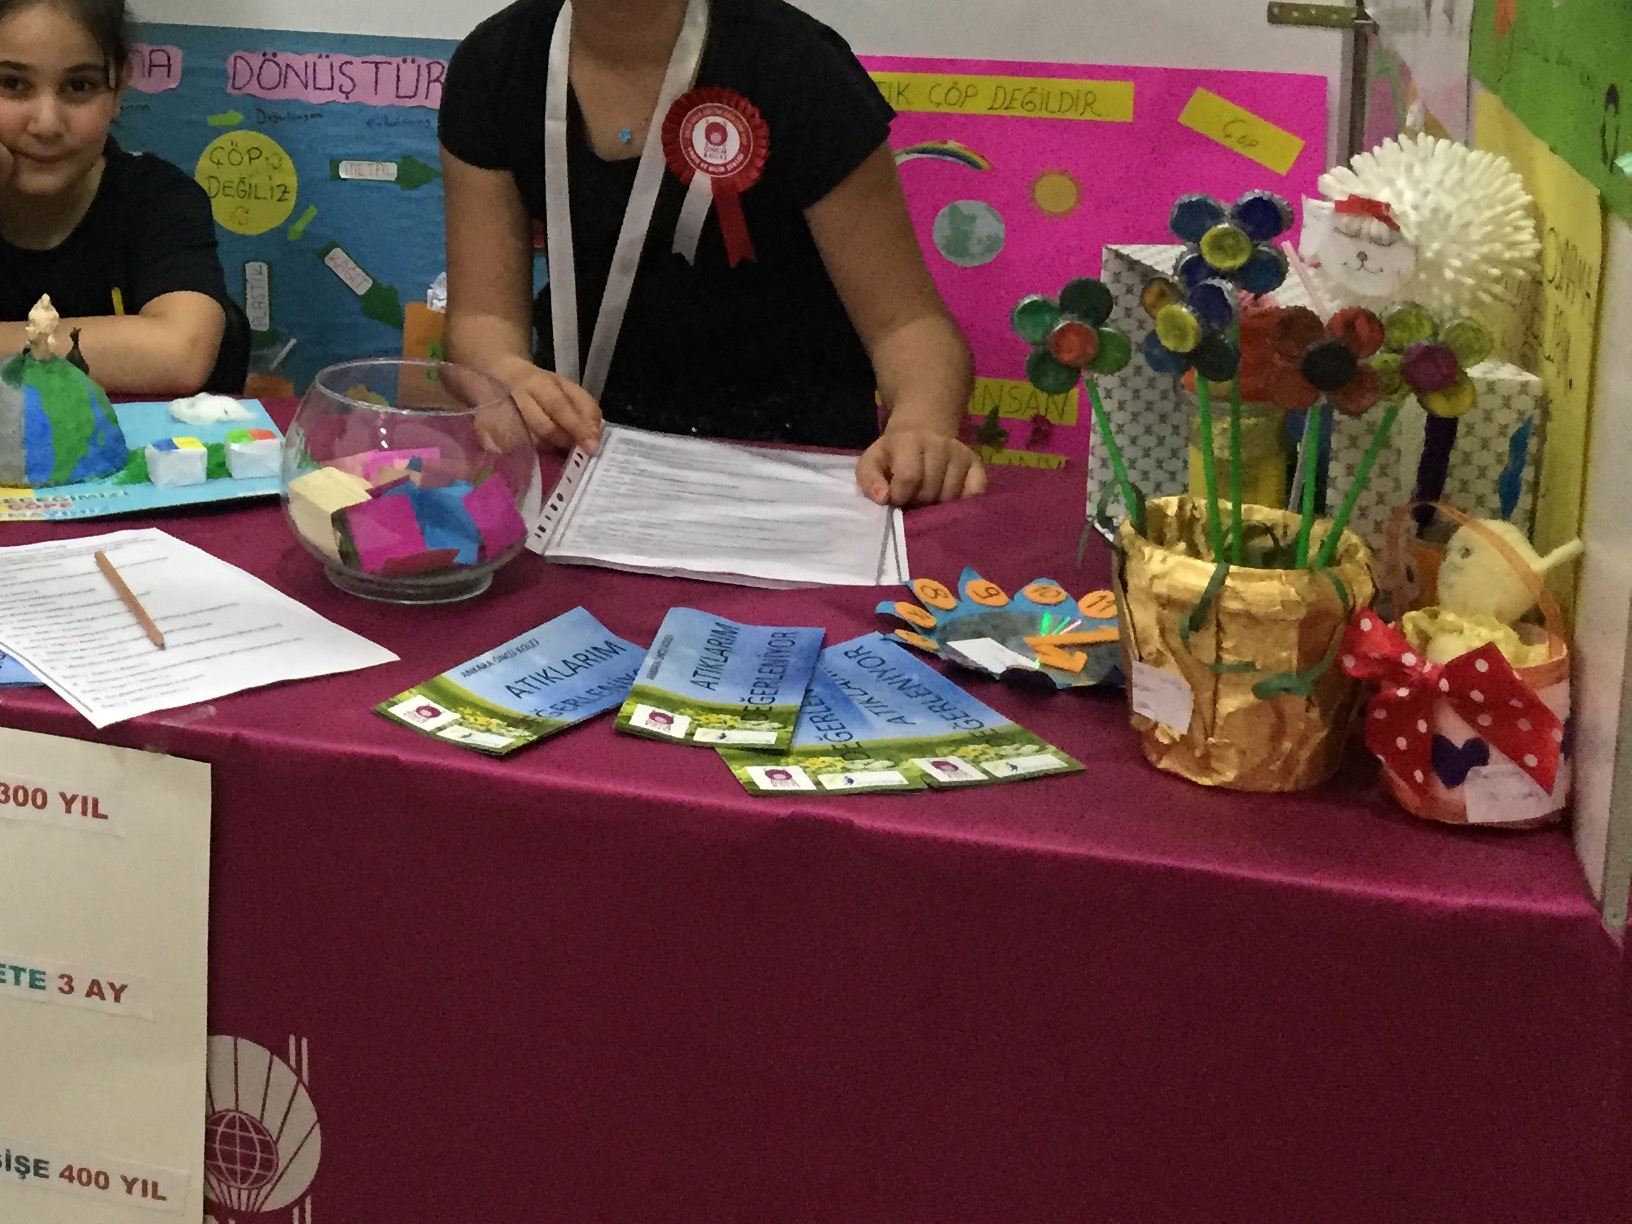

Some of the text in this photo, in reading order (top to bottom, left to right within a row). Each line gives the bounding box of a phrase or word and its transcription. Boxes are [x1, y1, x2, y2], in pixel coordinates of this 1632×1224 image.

[505, 640, 627, 700] ATIKLARIM
[690, 622, 741, 691] ATIKLARIM
[58, 791, 109, 819] YIL
[57, 973, 75, 995] 3
[85, 978, 128, 1004] AY
[58, 1164, 110, 1191] 400
[120, 1174, 167, 1202] YIL
